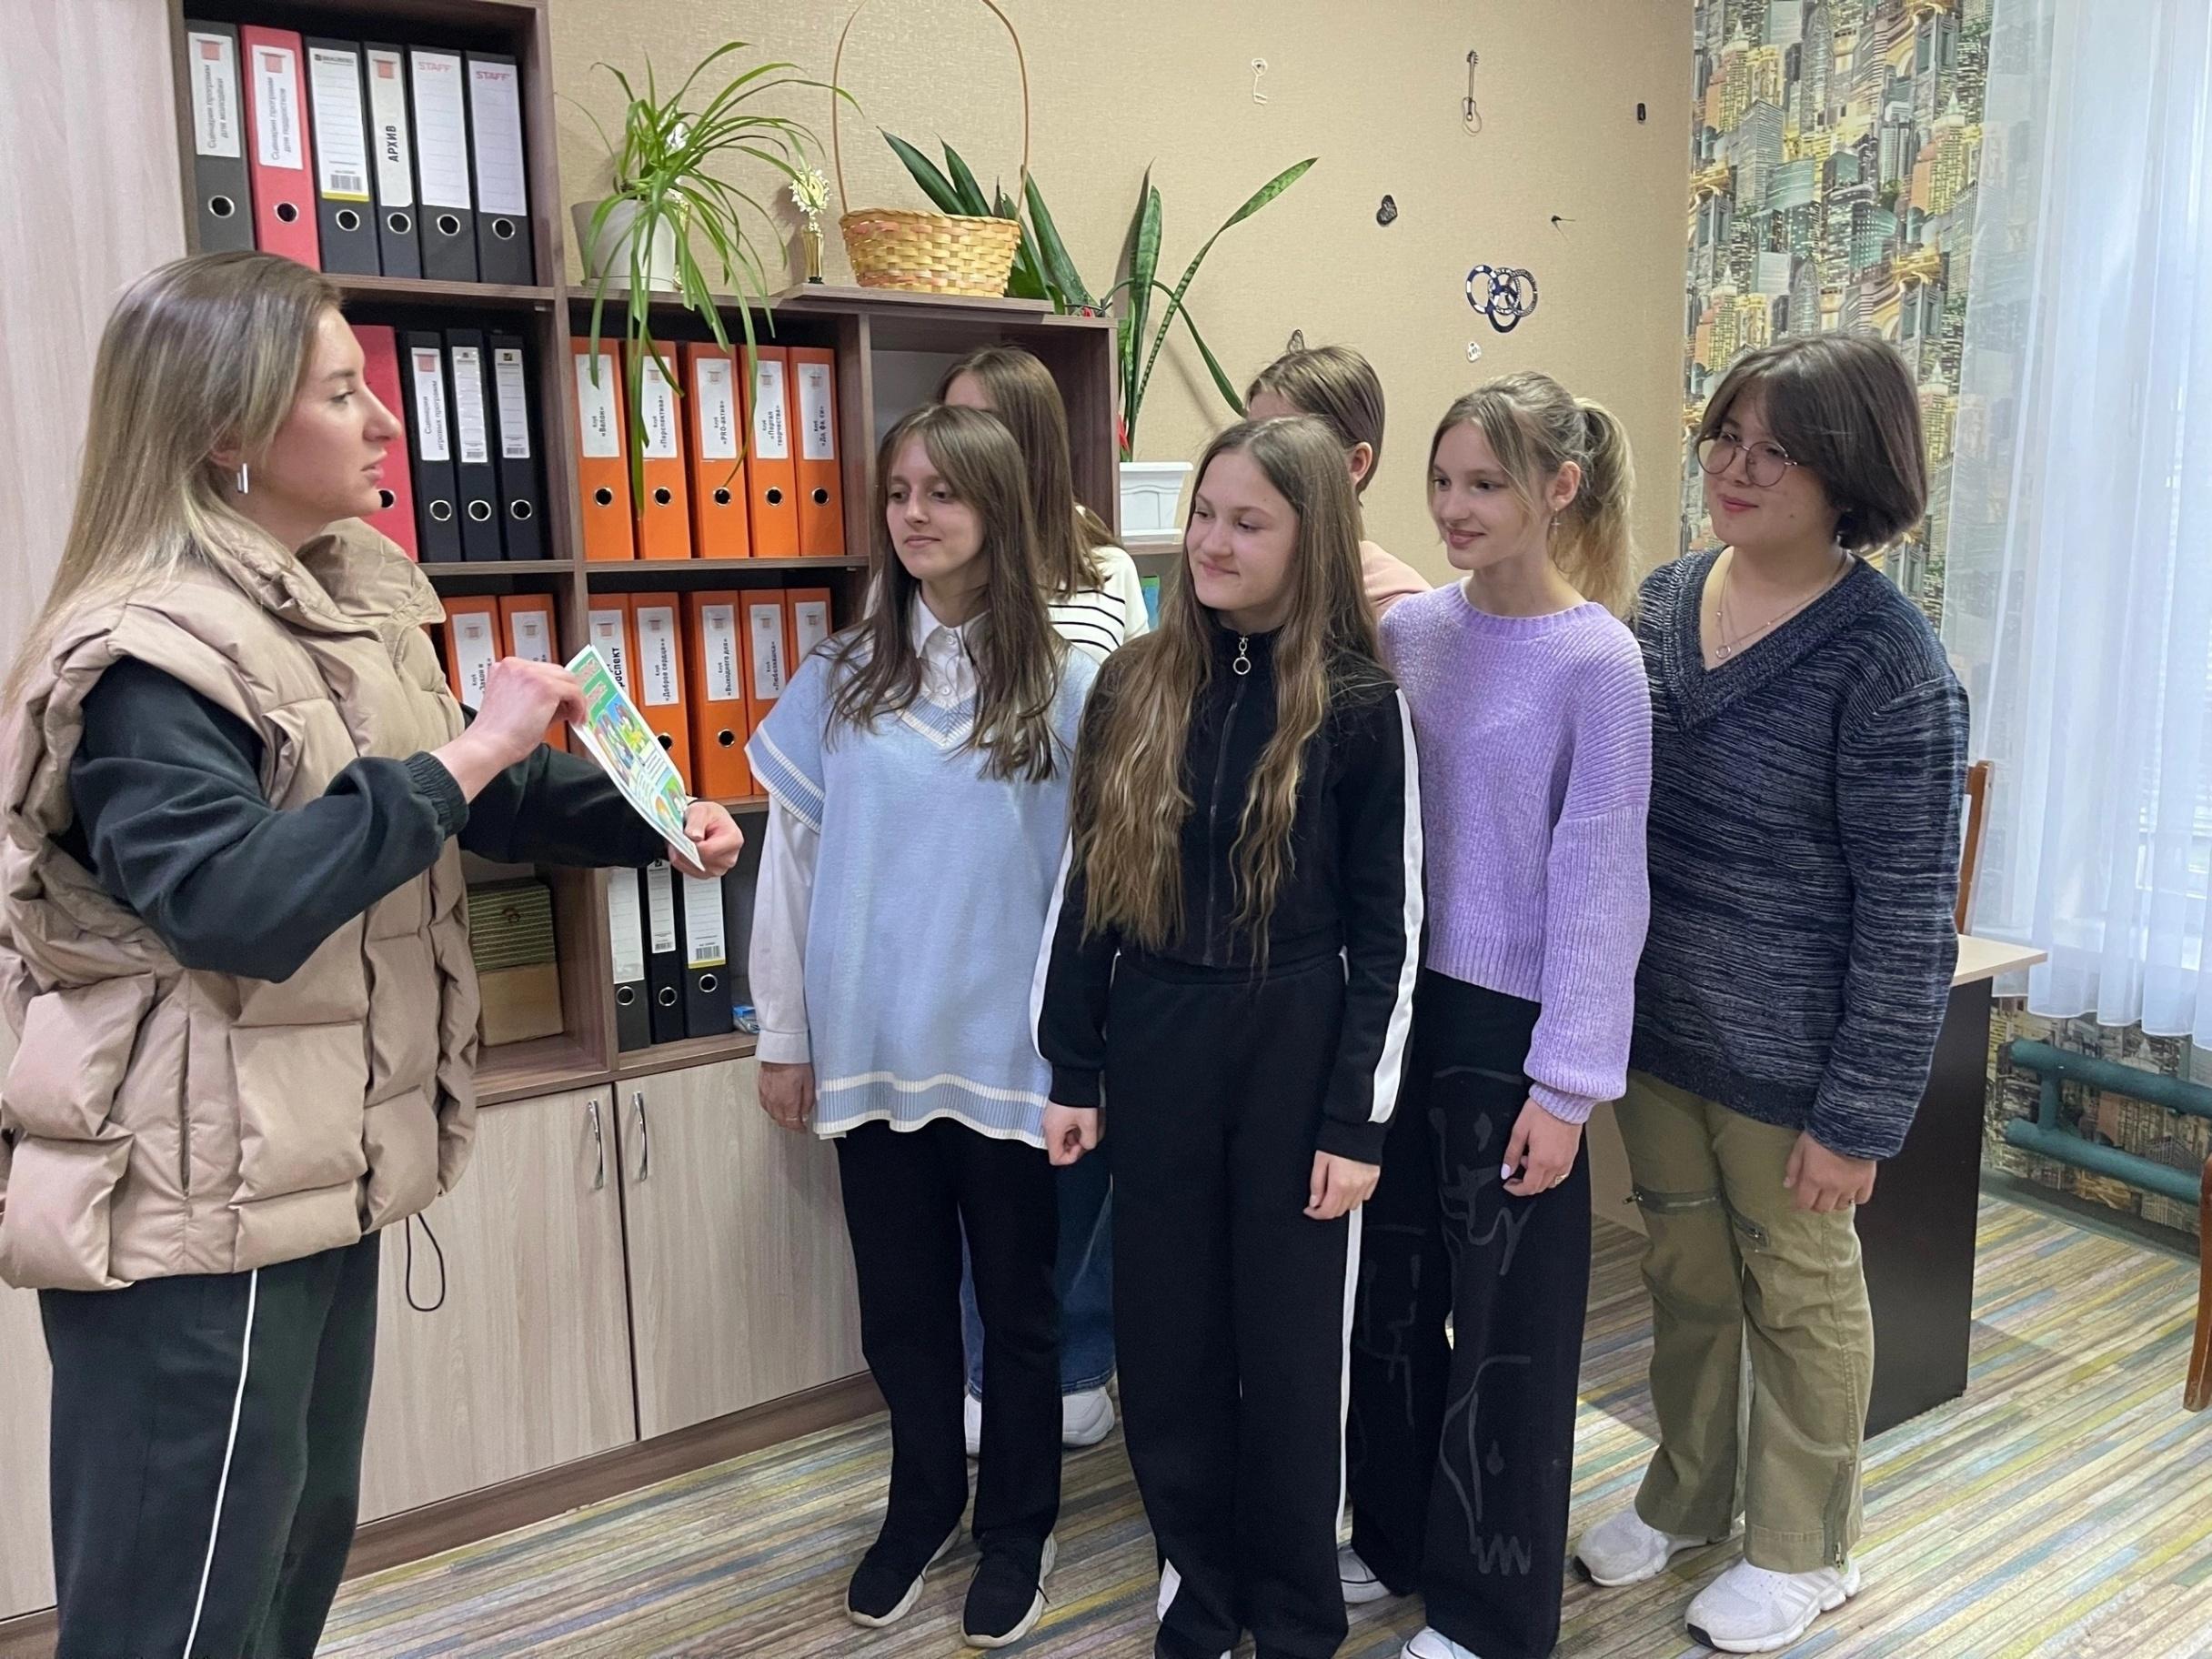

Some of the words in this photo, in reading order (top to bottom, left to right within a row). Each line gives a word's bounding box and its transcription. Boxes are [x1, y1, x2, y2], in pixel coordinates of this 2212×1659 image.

[417, 61, 452, 73] STAFF
[476, 71, 510, 82] STAFF
[386, 125, 399, 163] АРХИВ
[432, 380, 441, 417] программ
[423, 396, 432, 435] Сценарии
[436, 420, 445, 450] игровых
